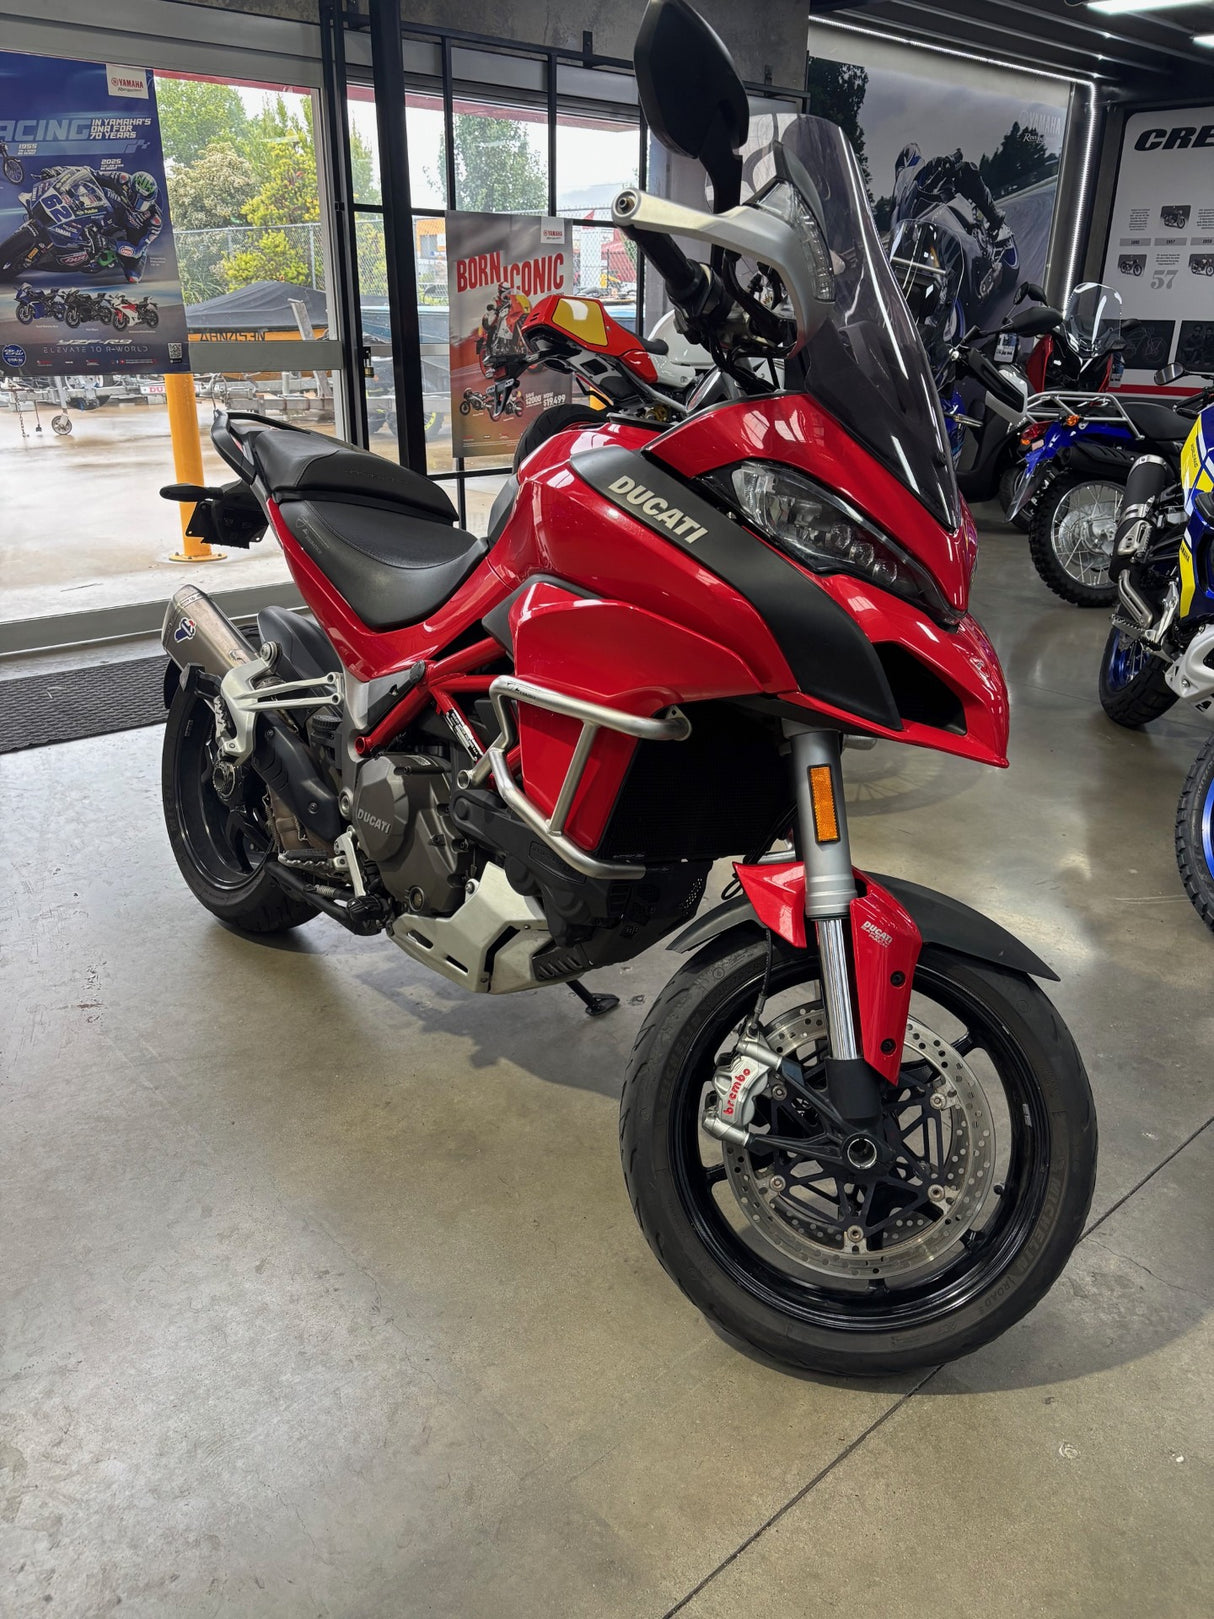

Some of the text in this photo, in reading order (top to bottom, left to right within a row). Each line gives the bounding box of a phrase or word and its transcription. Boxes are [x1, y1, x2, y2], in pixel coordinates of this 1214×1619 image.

[118, 78, 144, 88] YAMAHA
[104, 118, 151, 127] YAMAHA'S
[1029, 111, 1061, 135] YAMAHA
[105, 131, 137, 139] YEARS
[457, 251, 501, 293] BORN
[503, 252, 564, 297] ICONIC
[1150, 269, 1179, 290] 57
[608, 475, 709, 544] DUCATI
[357, 808, 391, 833] DUCATI
[861, 920, 893, 944] DUCATI
[723, 1068, 751, 1116] brembo
